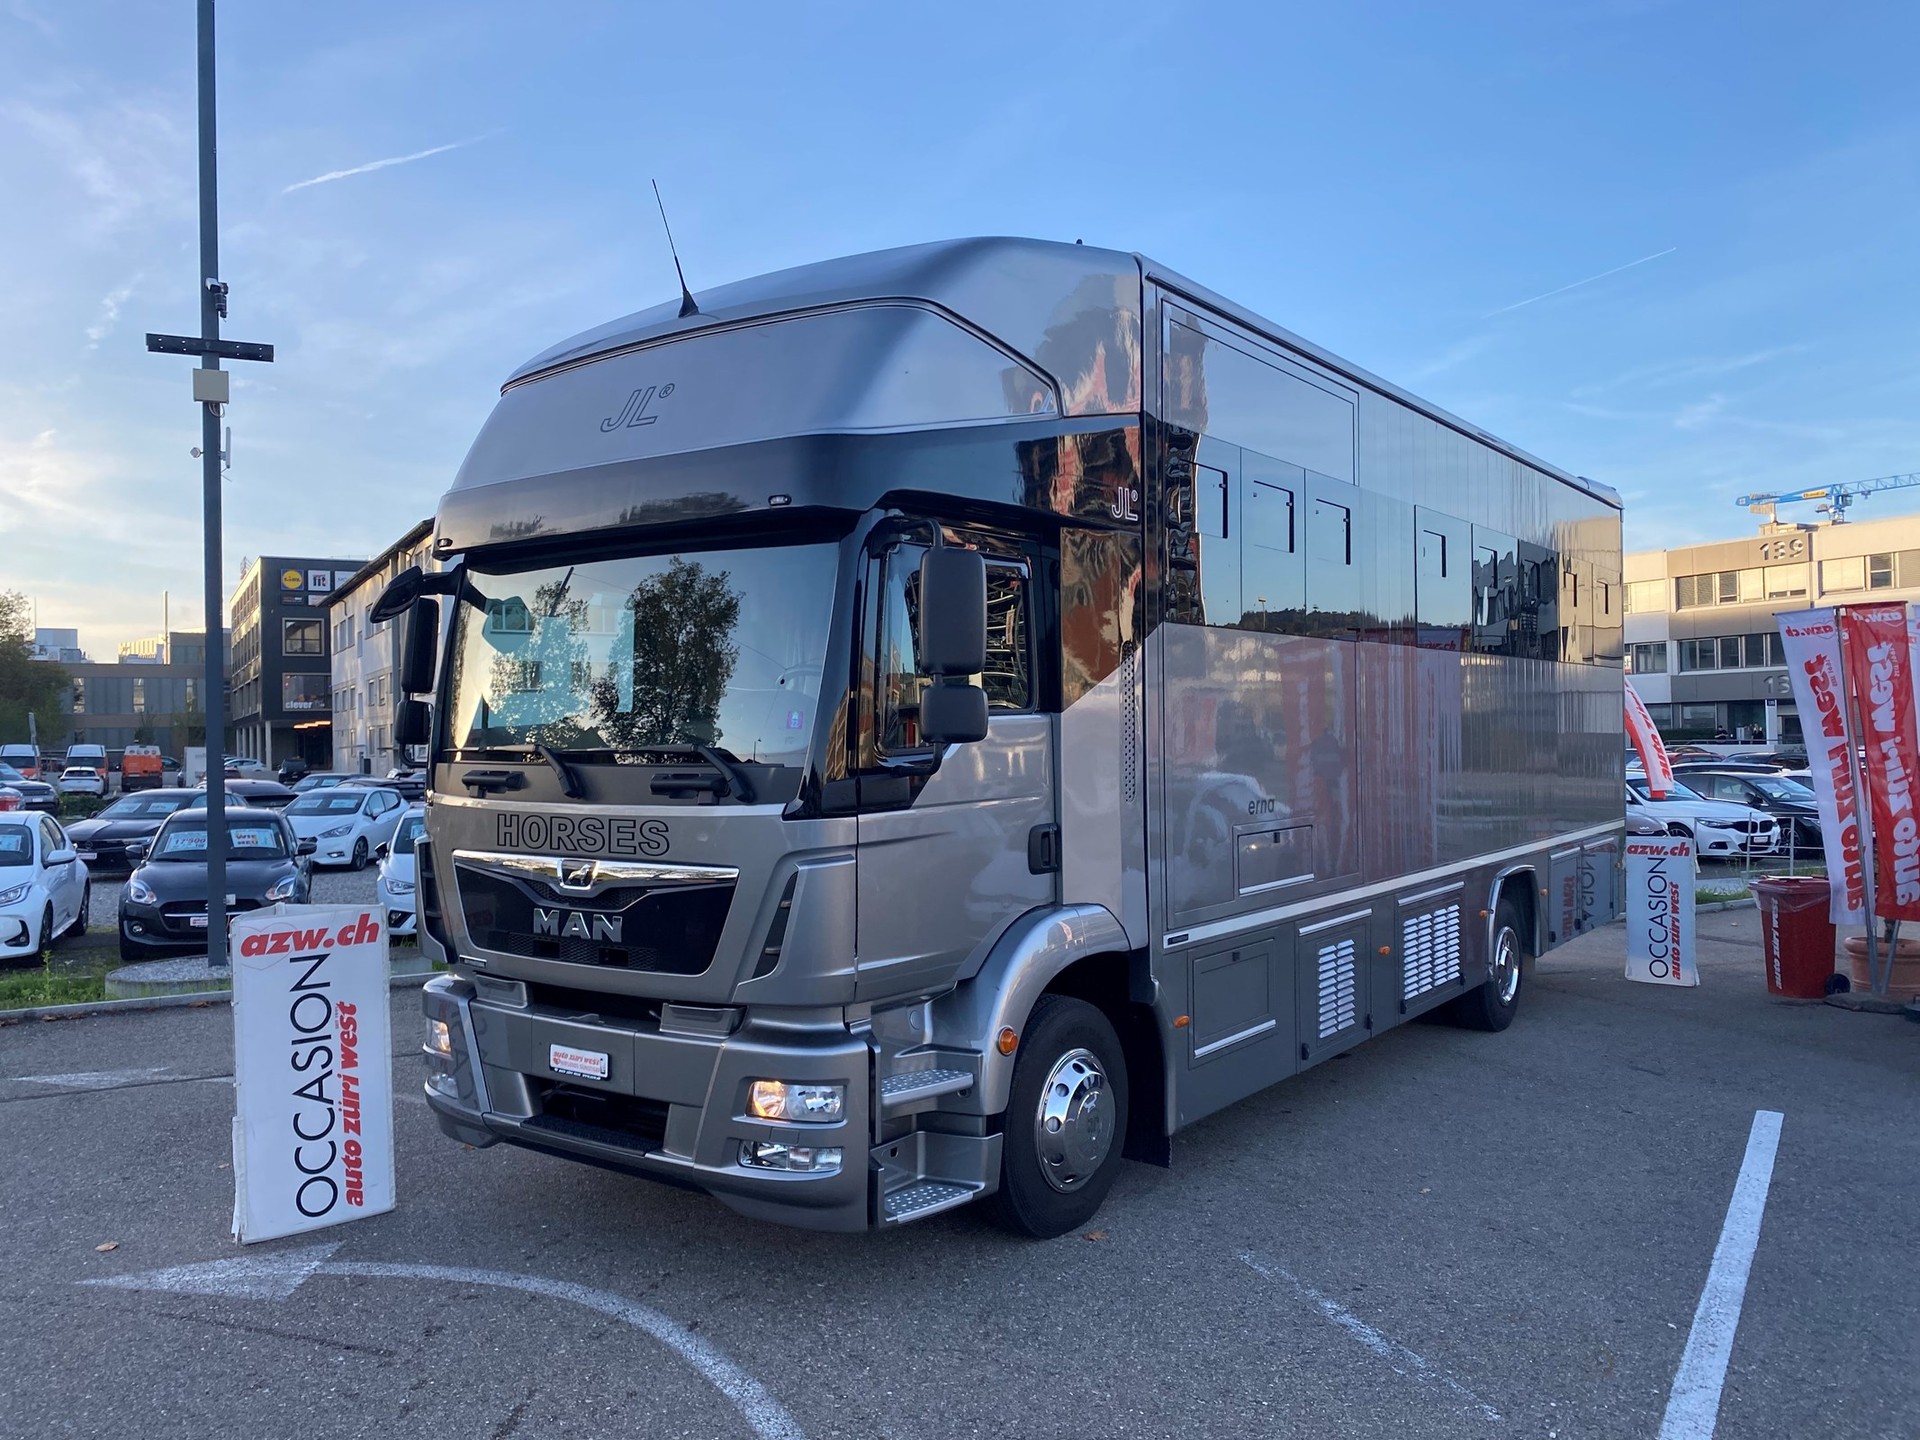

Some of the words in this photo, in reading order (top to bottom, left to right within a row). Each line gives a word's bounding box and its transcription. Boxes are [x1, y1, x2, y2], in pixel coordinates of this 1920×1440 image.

[1759, 538, 1804, 561] 139
[1763, 674, 1792, 694] 13
[1248, 799, 1275, 815] erna
[496, 813, 670, 857] HORSES
[1626, 842, 1690, 857] azw.ch
[1668, 881, 1680, 915] west
[532, 908, 623, 943] MAN
[1647, 857, 1669, 978] OCCASION
[1669, 914, 1681, 947] züri
[240, 913, 380, 958] azw.ch
[1671, 947, 1681, 980] auto
[335, 1001, 359, 1070] west
[289, 952, 339, 1218] OCCASION
[337, 1073, 362, 1137] züri
[341, 1138, 364, 1207] auto
